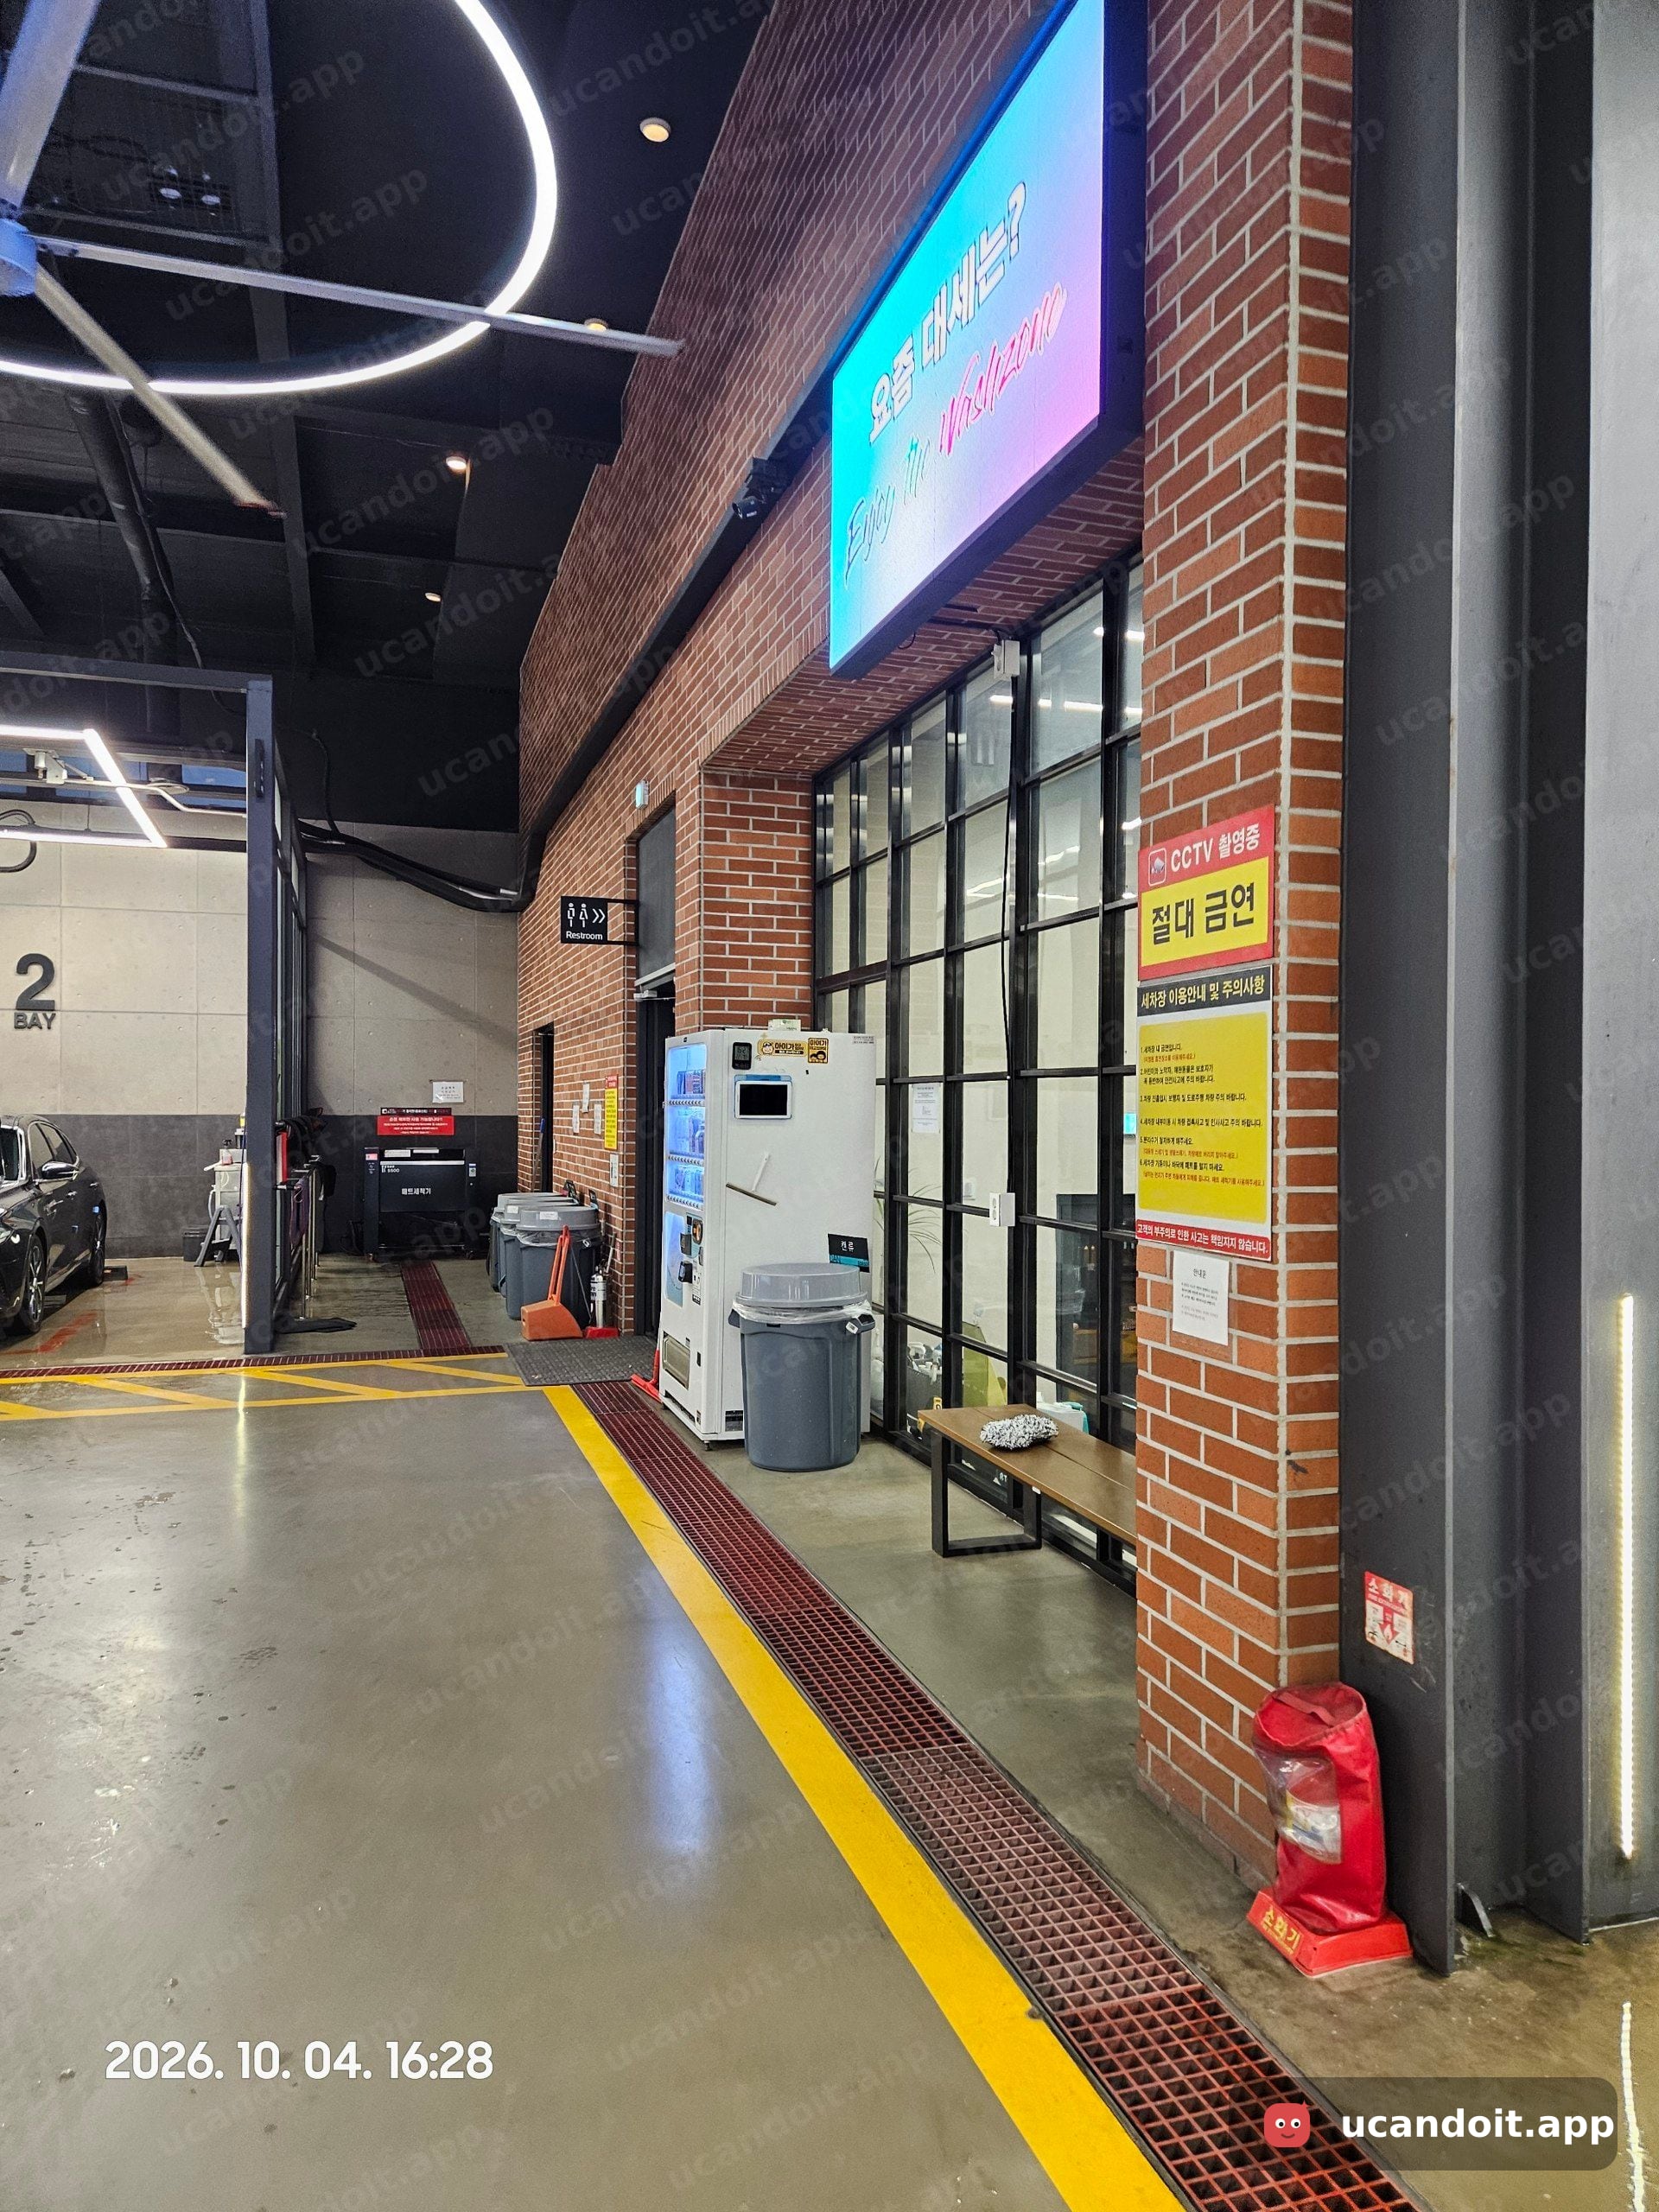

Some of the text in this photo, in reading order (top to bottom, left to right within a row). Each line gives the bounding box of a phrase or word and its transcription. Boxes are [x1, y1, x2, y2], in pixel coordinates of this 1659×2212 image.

[868, 181, 1027, 447] 요즘 대세는?
[845, 483, 896, 589] Enjoy
[1171, 823, 1261, 873] CCTV 촬영중
[1152, 881, 1255, 945] 절대 금연
[565, 930, 603, 942] Restroom
[16, 952, 56, 1011] 2
[1141, 975, 1265, 1009] 세차장 이용안내 및 주의사항
[13, 1012, 57, 1030] BAY
[774, 1042, 794, 1051] 아이가
[1216, 1092, 1225, 1102] 주의
[1230, 1118, 1241, 1127] 주의
[841, 1240, 855, 1253] 캔류
[1136, 1223, 1268, 1254] 고객의 부주의로 인한 사고는 책임지지 않습니다.
[1368, 1577, 1408, 1611] 소화기
[1262, 1904, 1301, 1951] 소화기
